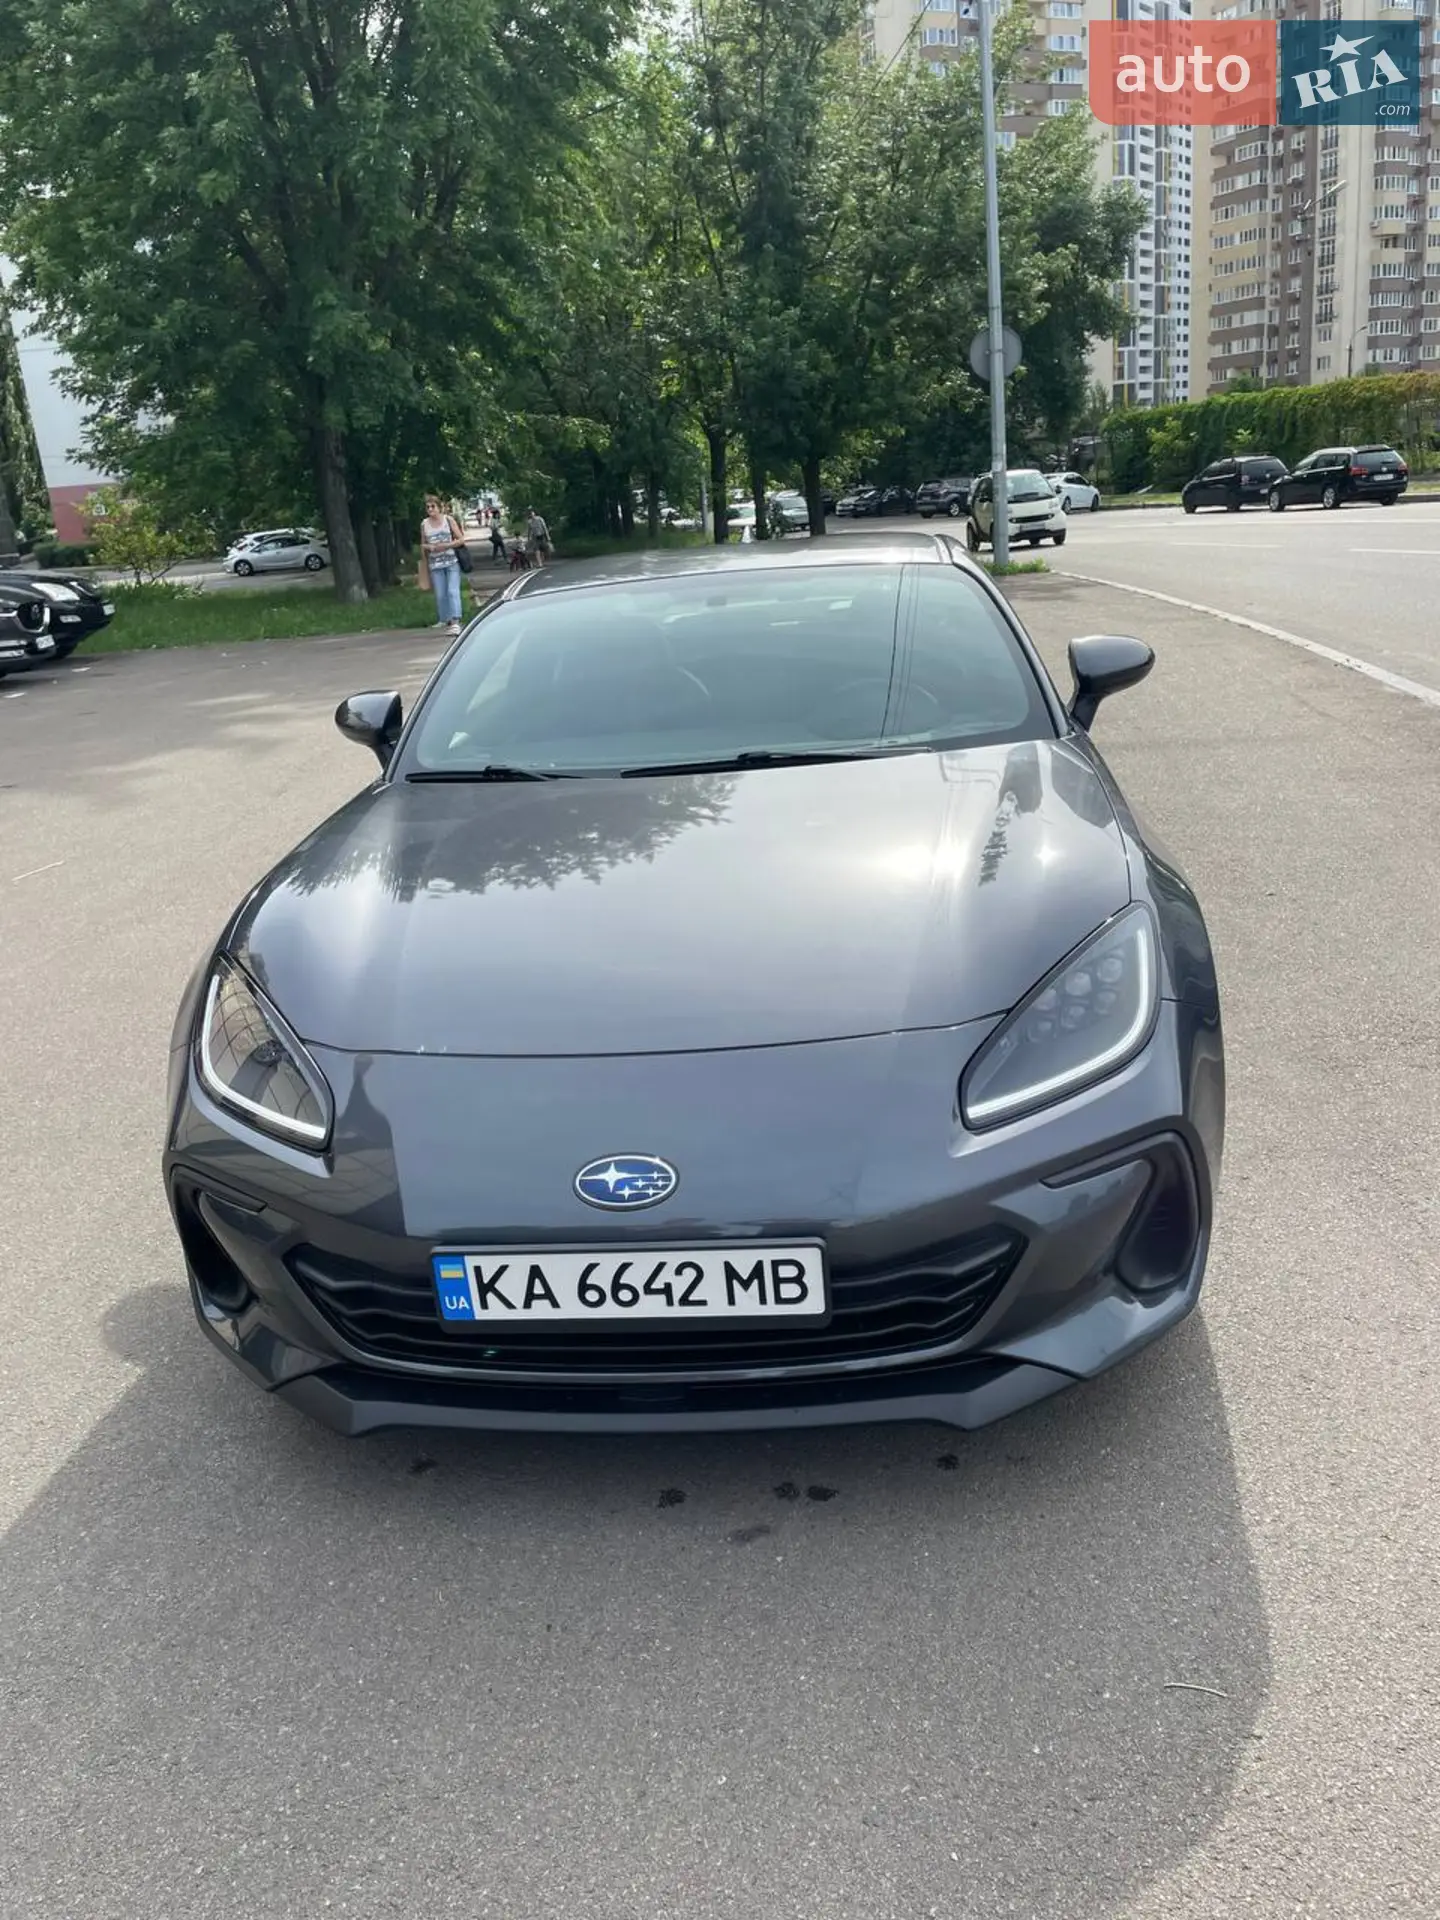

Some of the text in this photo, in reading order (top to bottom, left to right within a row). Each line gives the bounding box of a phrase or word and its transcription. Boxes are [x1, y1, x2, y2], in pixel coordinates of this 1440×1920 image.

[473, 1258, 810, 1311] KA 6642 MB
[445, 1295, 469, 1310] UA
